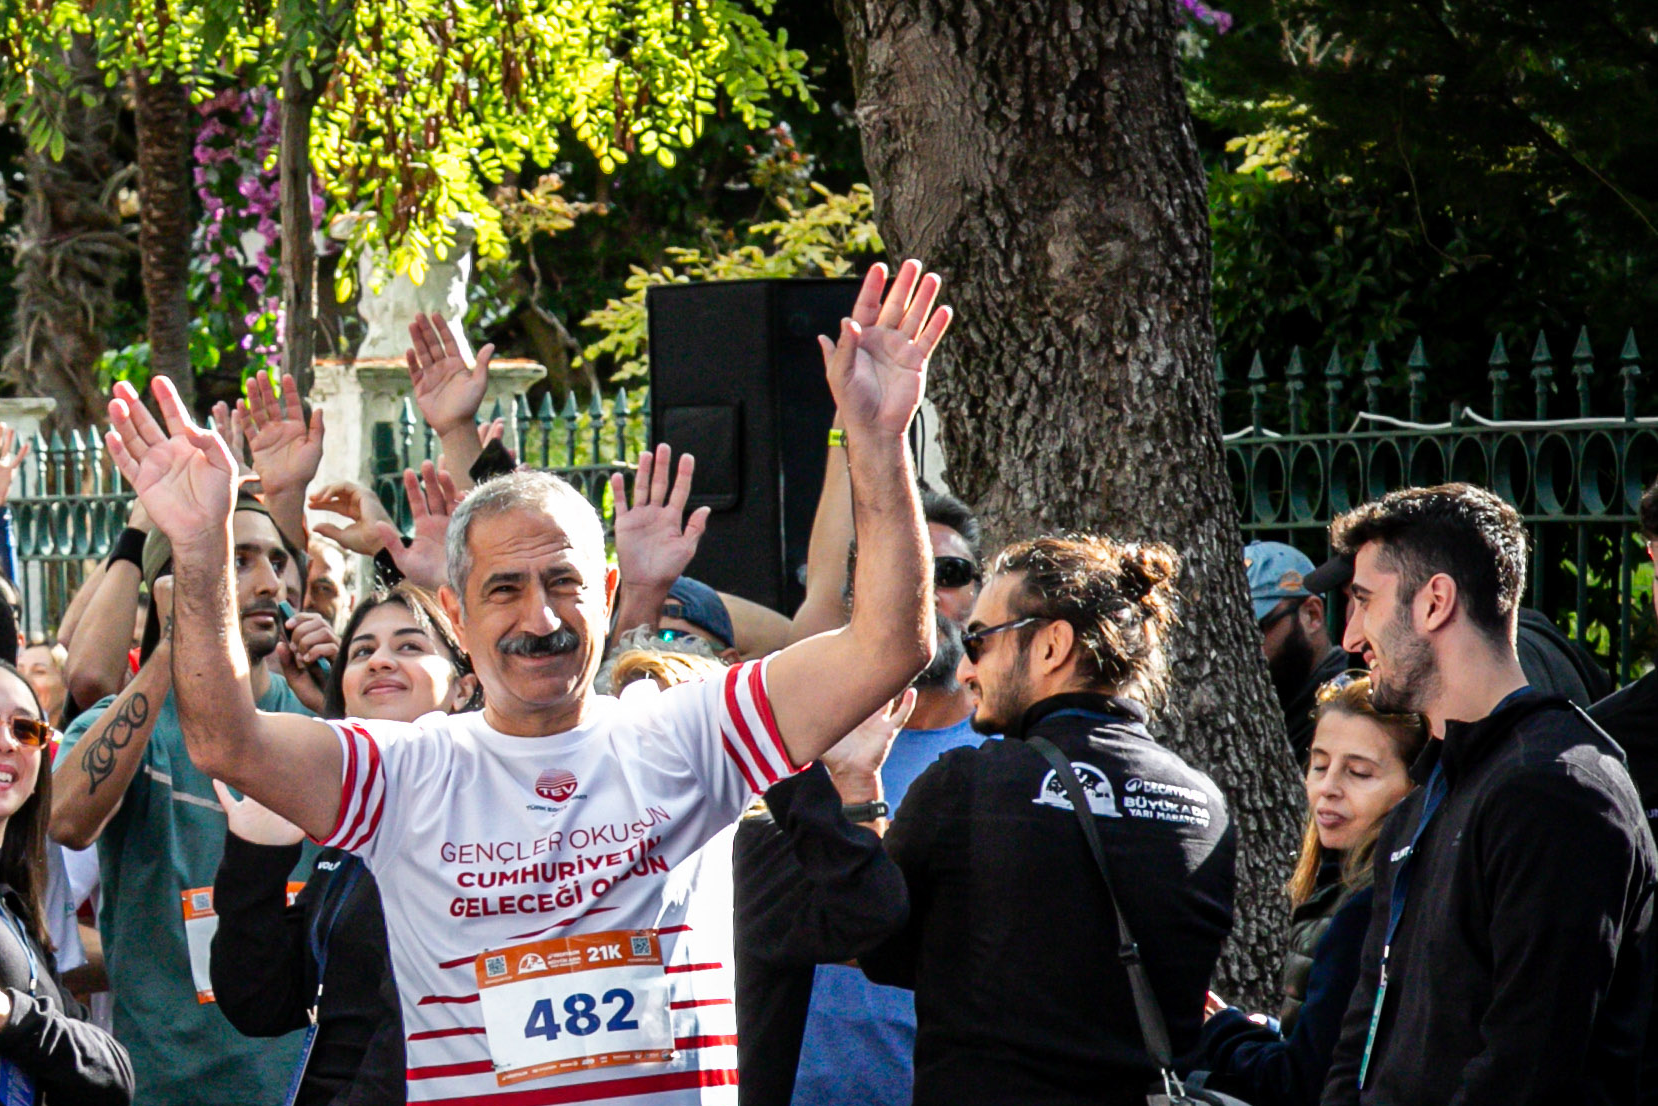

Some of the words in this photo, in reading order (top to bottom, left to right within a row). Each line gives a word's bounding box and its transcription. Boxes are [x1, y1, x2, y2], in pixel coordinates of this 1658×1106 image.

[539, 784, 577, 797] TEV
[1124, 796, 1210, 820] BÜYÜKADA
[1129, 808, 1153, 818] YARI
[440, 831, 563, 865] GENÇLER
[569, 806, 671, 849] OKUSUN
[457, 836, 662, 888] CUMHURİYETİN
[450, 880, 582, 918] GELECEĞİ
[587, 944, 622, 962] 21K
[524, 988, 639, 1041] 482
